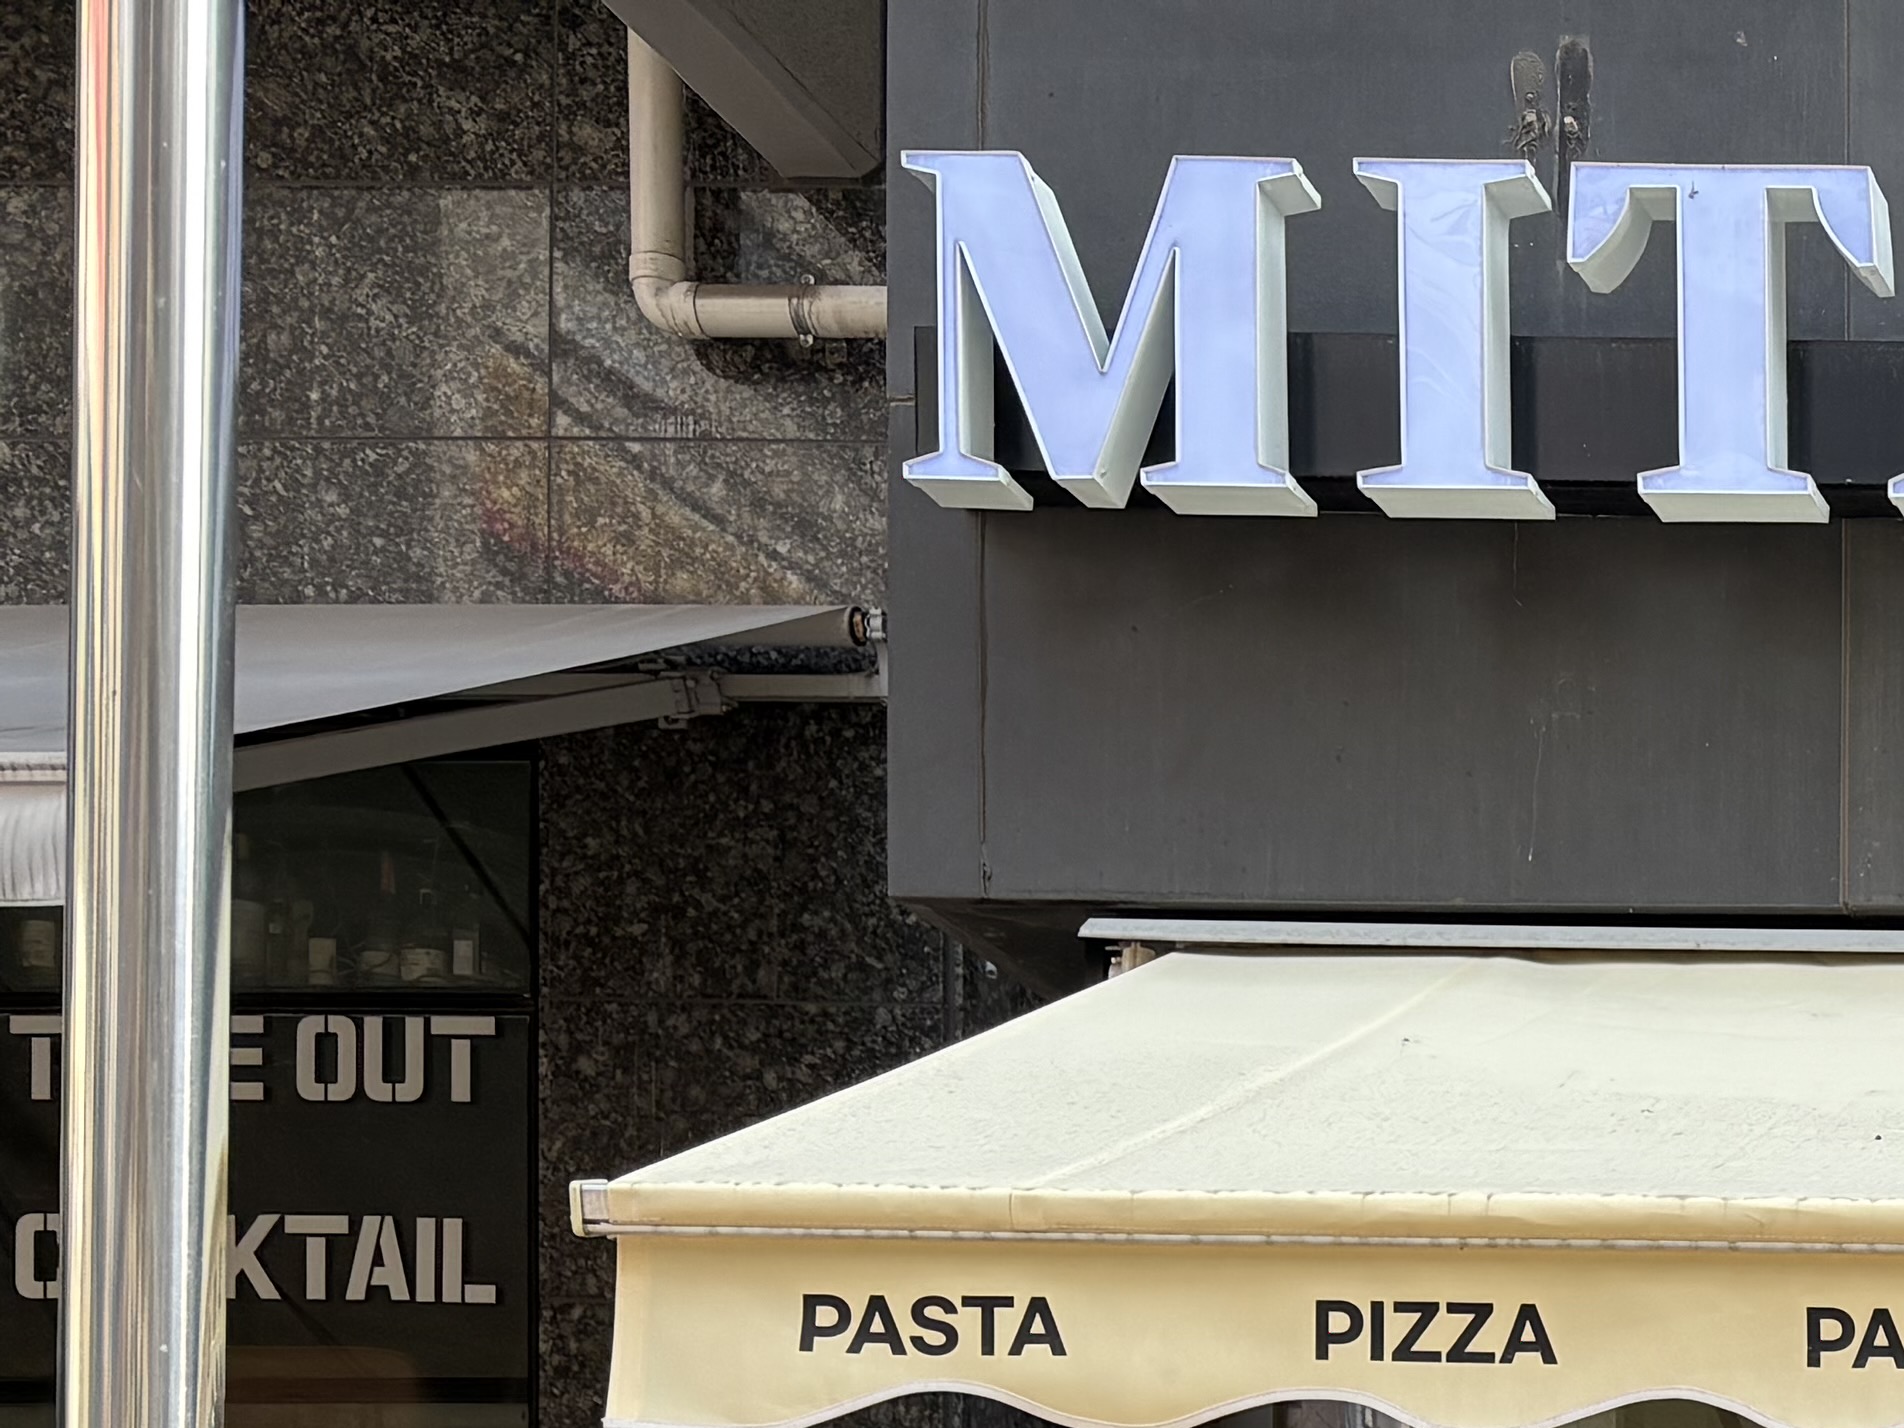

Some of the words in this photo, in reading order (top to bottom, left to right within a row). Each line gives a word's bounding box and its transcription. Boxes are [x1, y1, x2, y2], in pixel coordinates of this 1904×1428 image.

[9, 1014, 264, 1101] TE
[296, 1014, 496, 1102] OUT
[14, 1212, 496, 1304] CKTAIL
[798, 1294, 1067, 1358] PASTA
[1313, 1299, 1558, 1366] PIZZA
